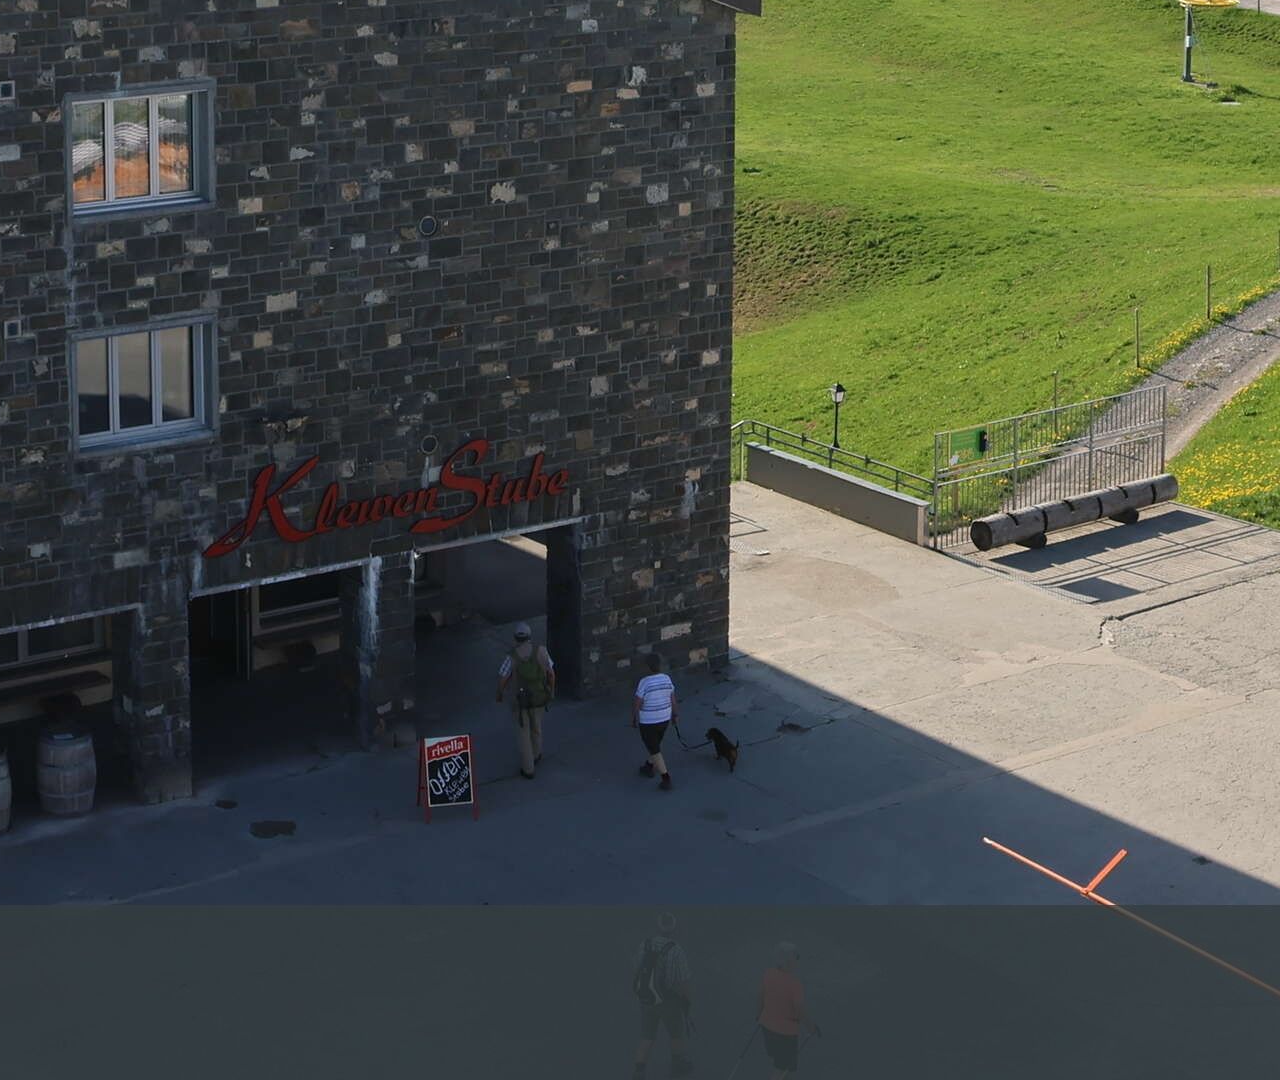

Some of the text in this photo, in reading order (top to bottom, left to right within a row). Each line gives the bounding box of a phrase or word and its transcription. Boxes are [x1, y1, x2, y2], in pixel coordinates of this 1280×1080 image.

[204, 439, 569, 558] Klewen Stube
[432, 739, 464, 757] rivella
